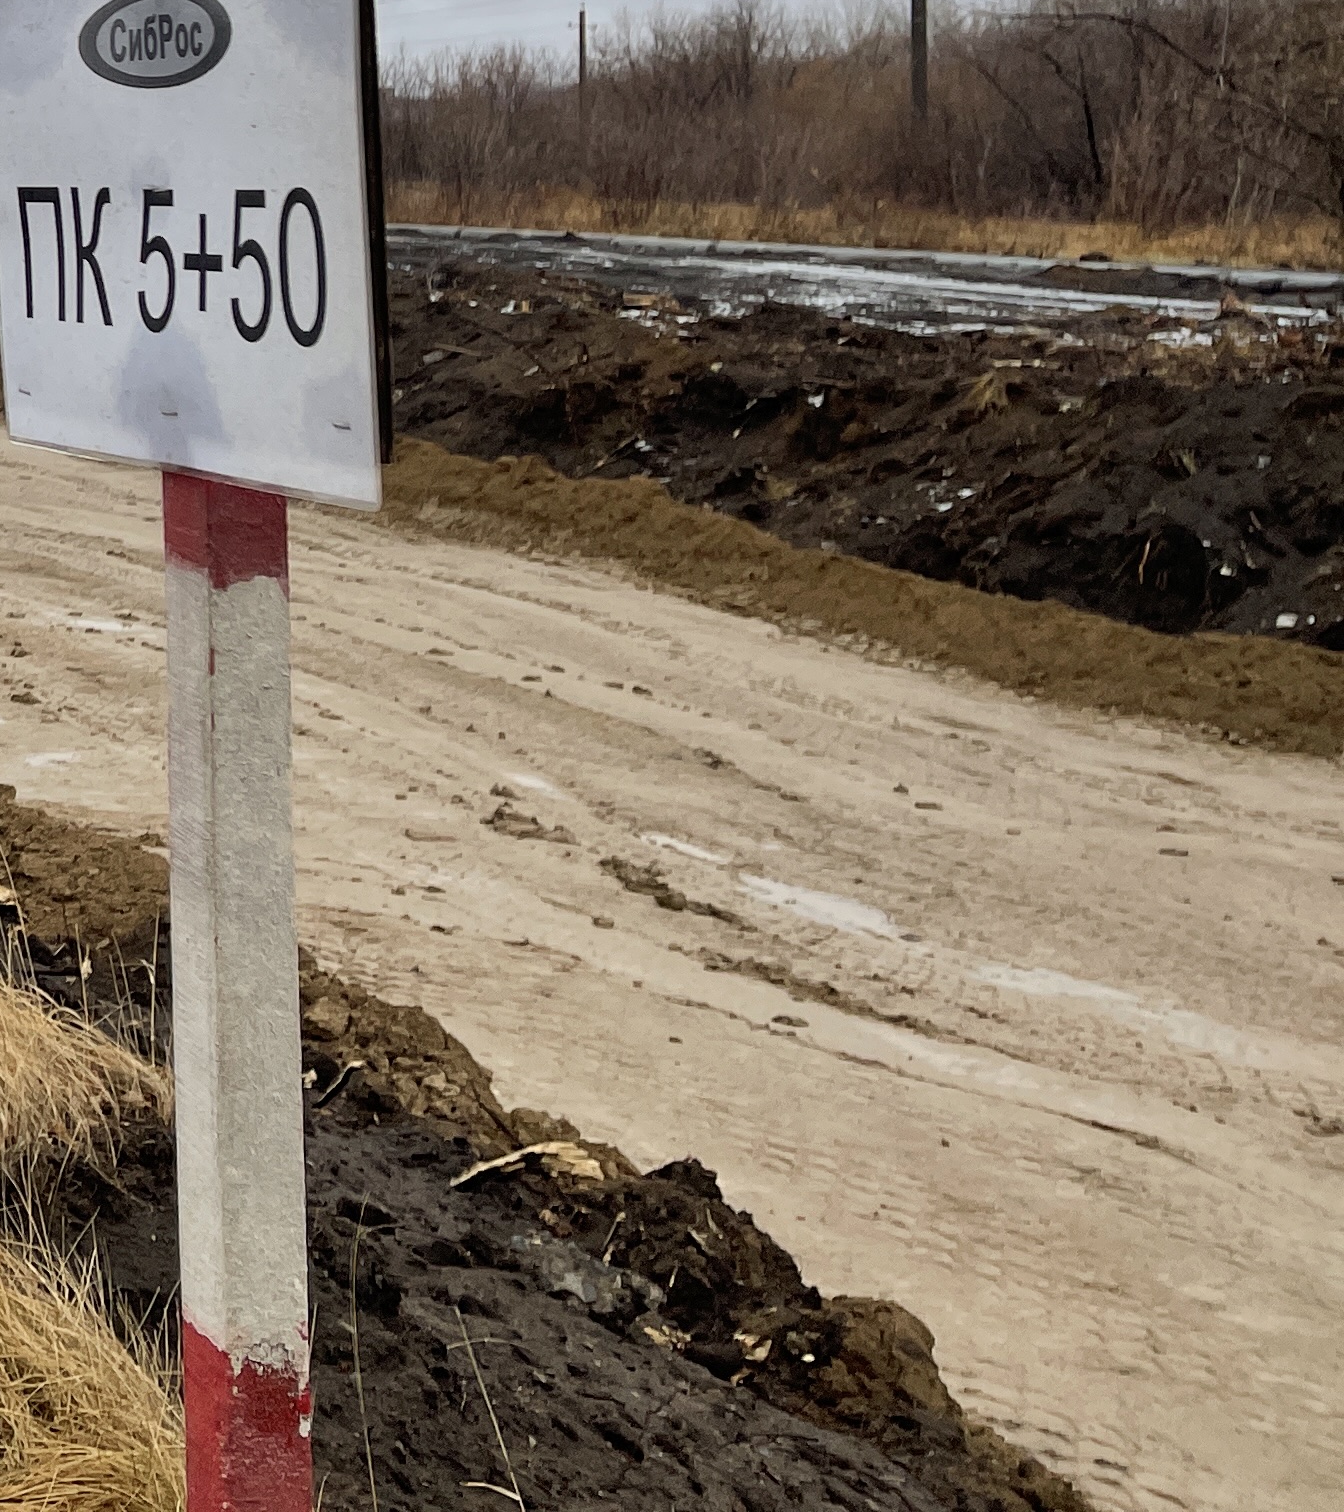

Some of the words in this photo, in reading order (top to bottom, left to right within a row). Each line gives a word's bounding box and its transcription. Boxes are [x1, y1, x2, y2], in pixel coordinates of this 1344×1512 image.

[110, 14, 203, 63] СибРос
[17, 187, 113, 326] ПК
[138, 187, 327, 347] 5+50
